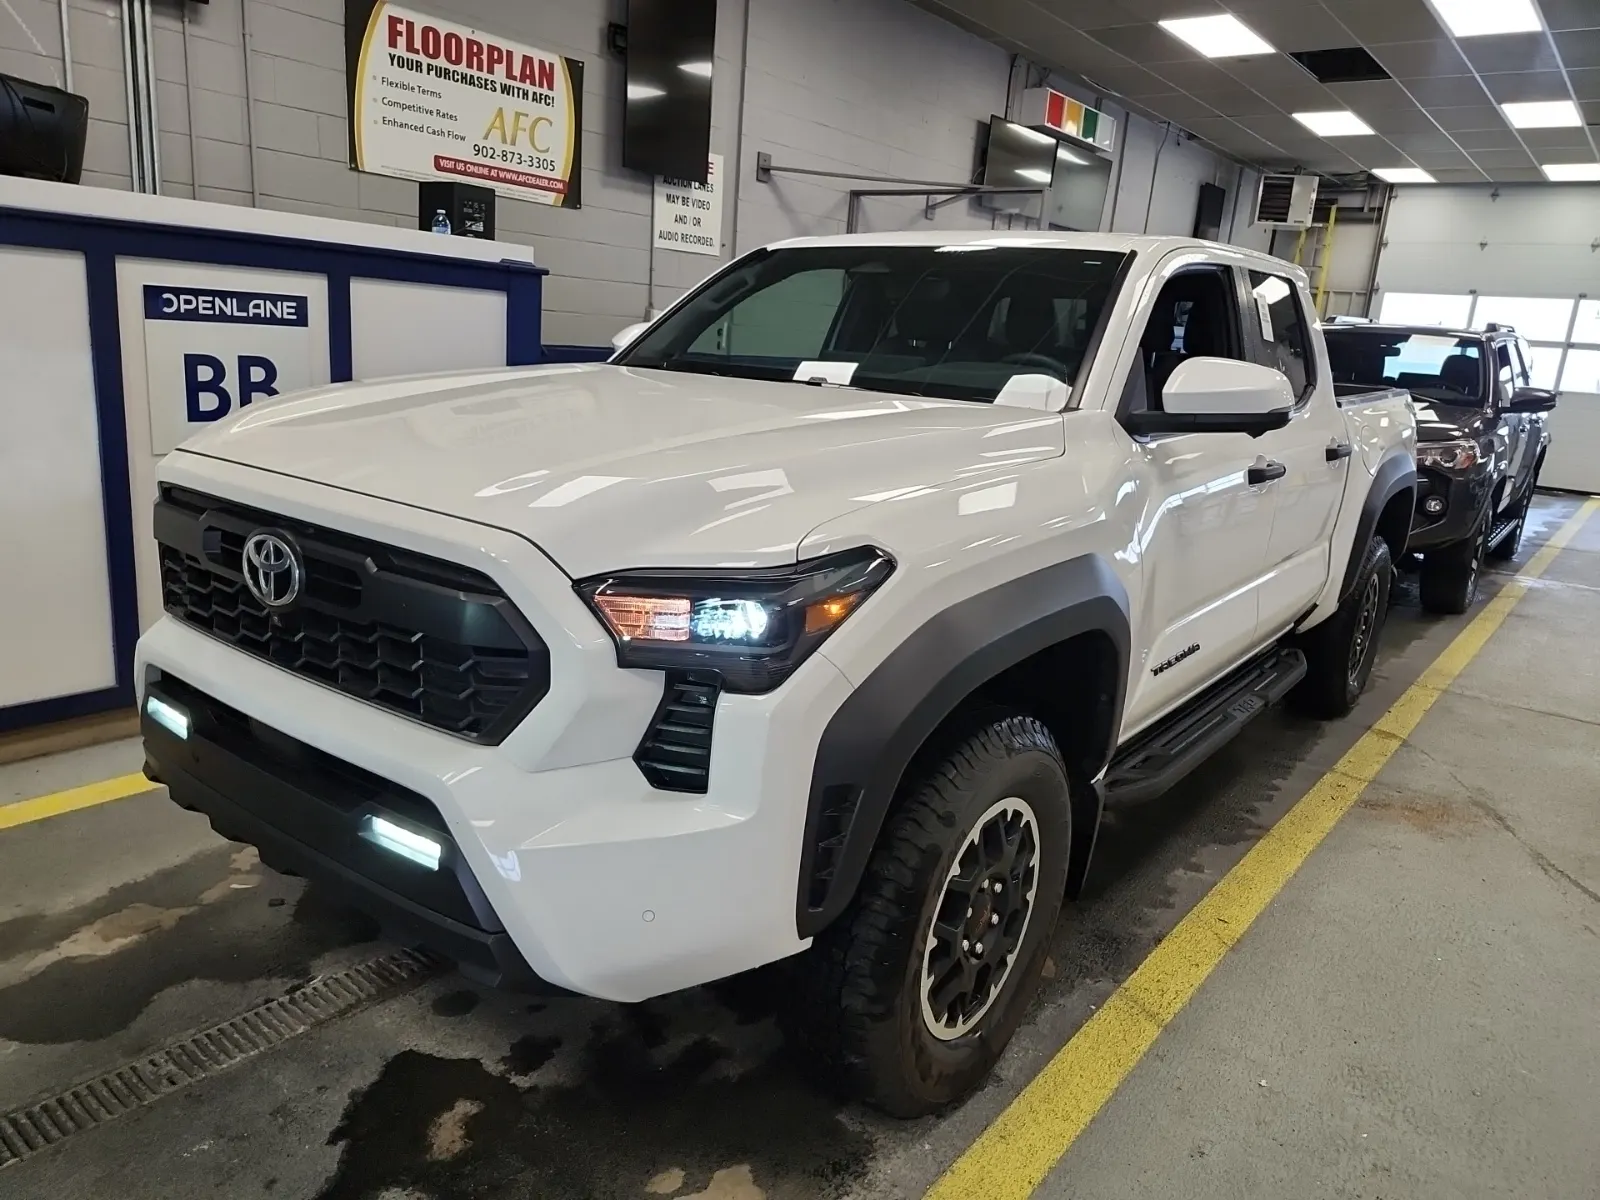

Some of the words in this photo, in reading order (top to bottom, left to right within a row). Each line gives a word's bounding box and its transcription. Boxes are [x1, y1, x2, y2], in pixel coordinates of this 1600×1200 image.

[387, 14, 555, 92] FLOORPLAN
[381, 76, 416, 93] Flexible
[416, 85, 442, 99] Terms
[388, 52, 424, 74] YOUR
[426, 63, 498, 93] PURCHASES
[499, 82, 529, 101] WITH
[531, 91, 555, 107] AFC!
[381, 97, 434, 117] Competitive
[435, 108, 458, 122] Rates
[382, 117, 424, 133] Enhanced
[426, 125, 445, 137] Cash
[447, 129, 466, 142] Flow
[482, 107, 553, 154] AFC
[473, 144, 556, 172] 902-873-3305
[439, 158, 455, 169] VISIT
[455, 161, 465, 172] US
[466, 163, 489, 176] ONLINE
[490, 168, 498, 177] AT
[498, 170, 564, 190] WWW.AFCDEALER.COM
[666, 193, 680, 205] MAY
[681, 196, 690, 207] BE
[691, 198, 711, 210] VIDEO
[674, 213, 688, 225] AND
[692, 217, 702, 228] OR
[658, 230, 679, 242] AUDIO
[680, 233, 715, 247] RECORDED.
[161, 292, 298, 320] OPENLANE
